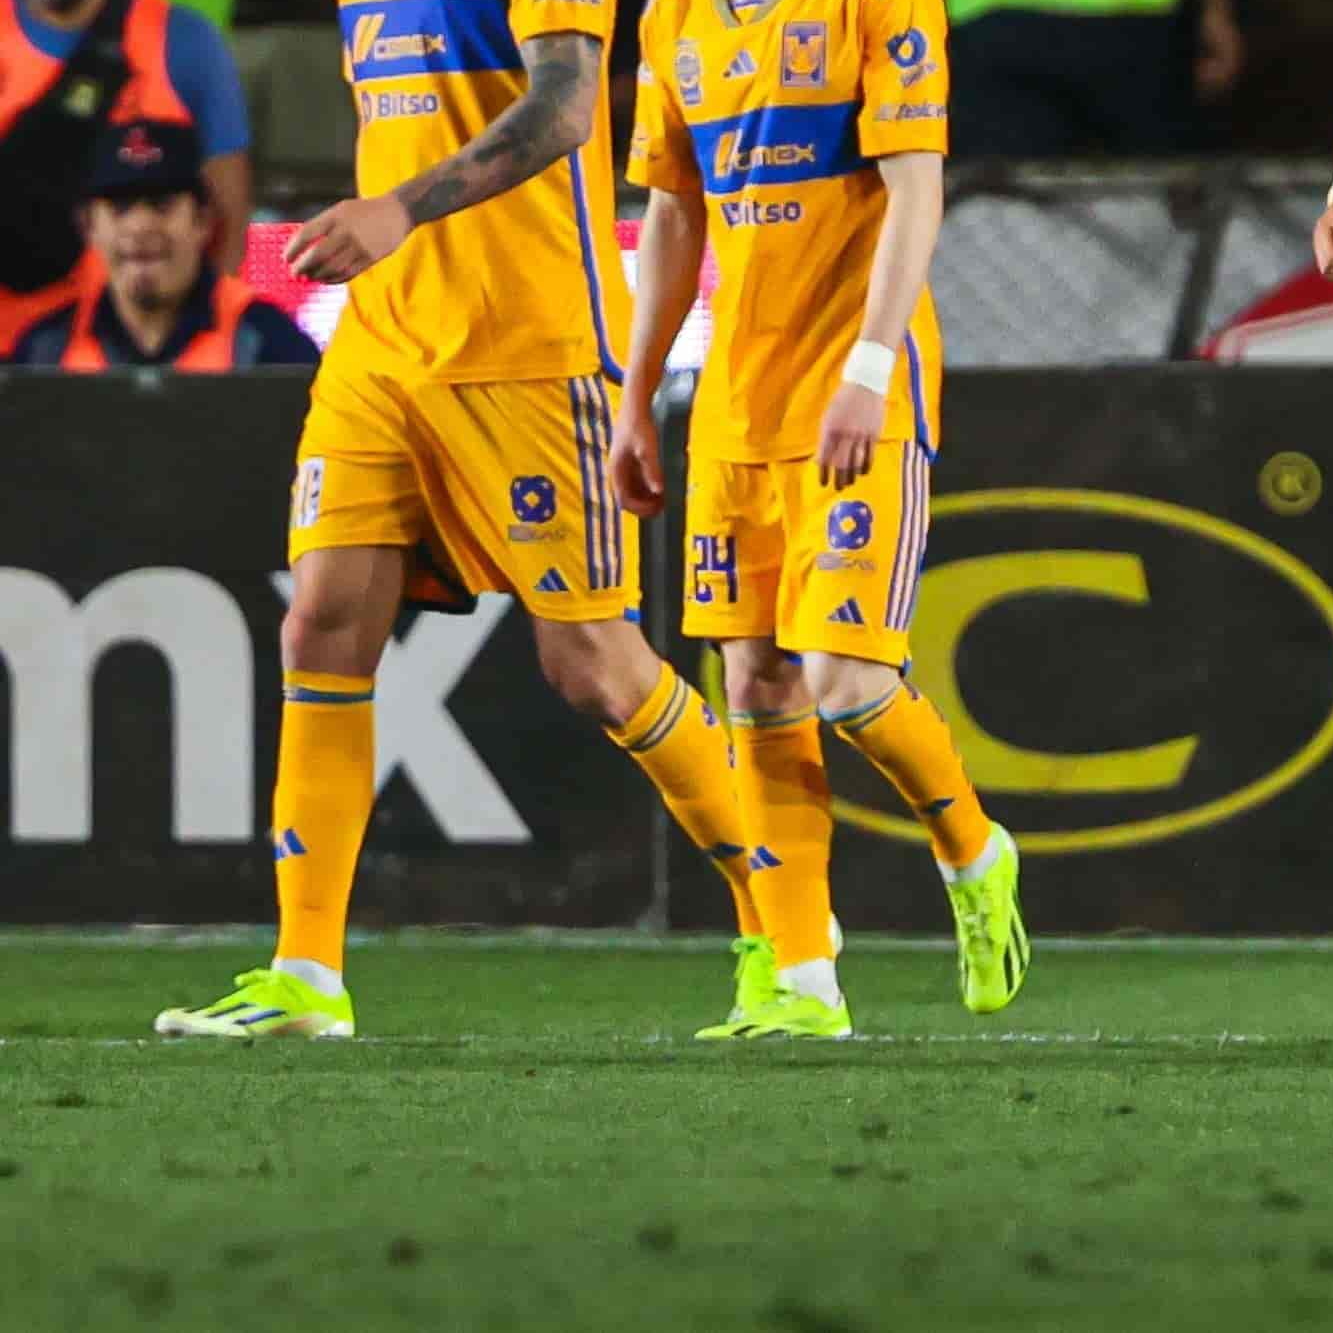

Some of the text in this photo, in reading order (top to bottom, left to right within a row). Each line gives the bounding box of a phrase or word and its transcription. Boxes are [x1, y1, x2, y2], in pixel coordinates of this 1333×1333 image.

[379, 92, 440, 118] Bitso
[720, 199, 802, 229] Bitso
[693, 534, 739, 604] 24
